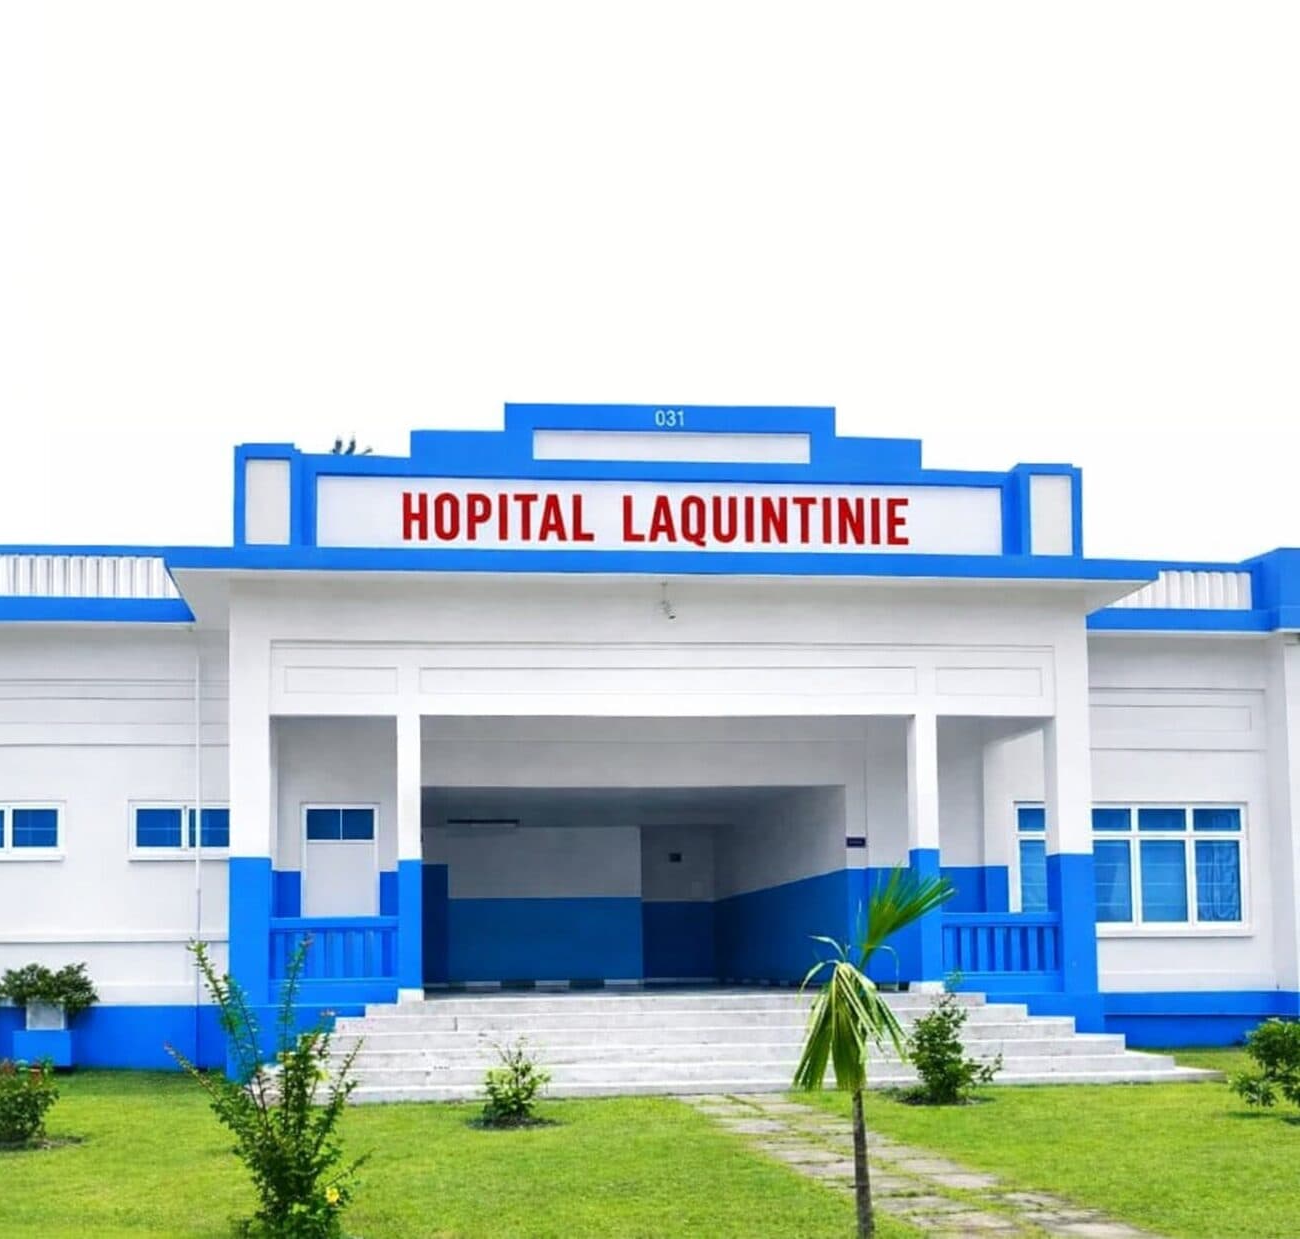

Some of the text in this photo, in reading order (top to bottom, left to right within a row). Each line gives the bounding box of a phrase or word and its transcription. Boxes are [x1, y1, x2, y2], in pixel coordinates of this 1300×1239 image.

[655, 409, 685, 427] 031
[402, 492, 910, 547] HOPITAL LAQUINTINIE
